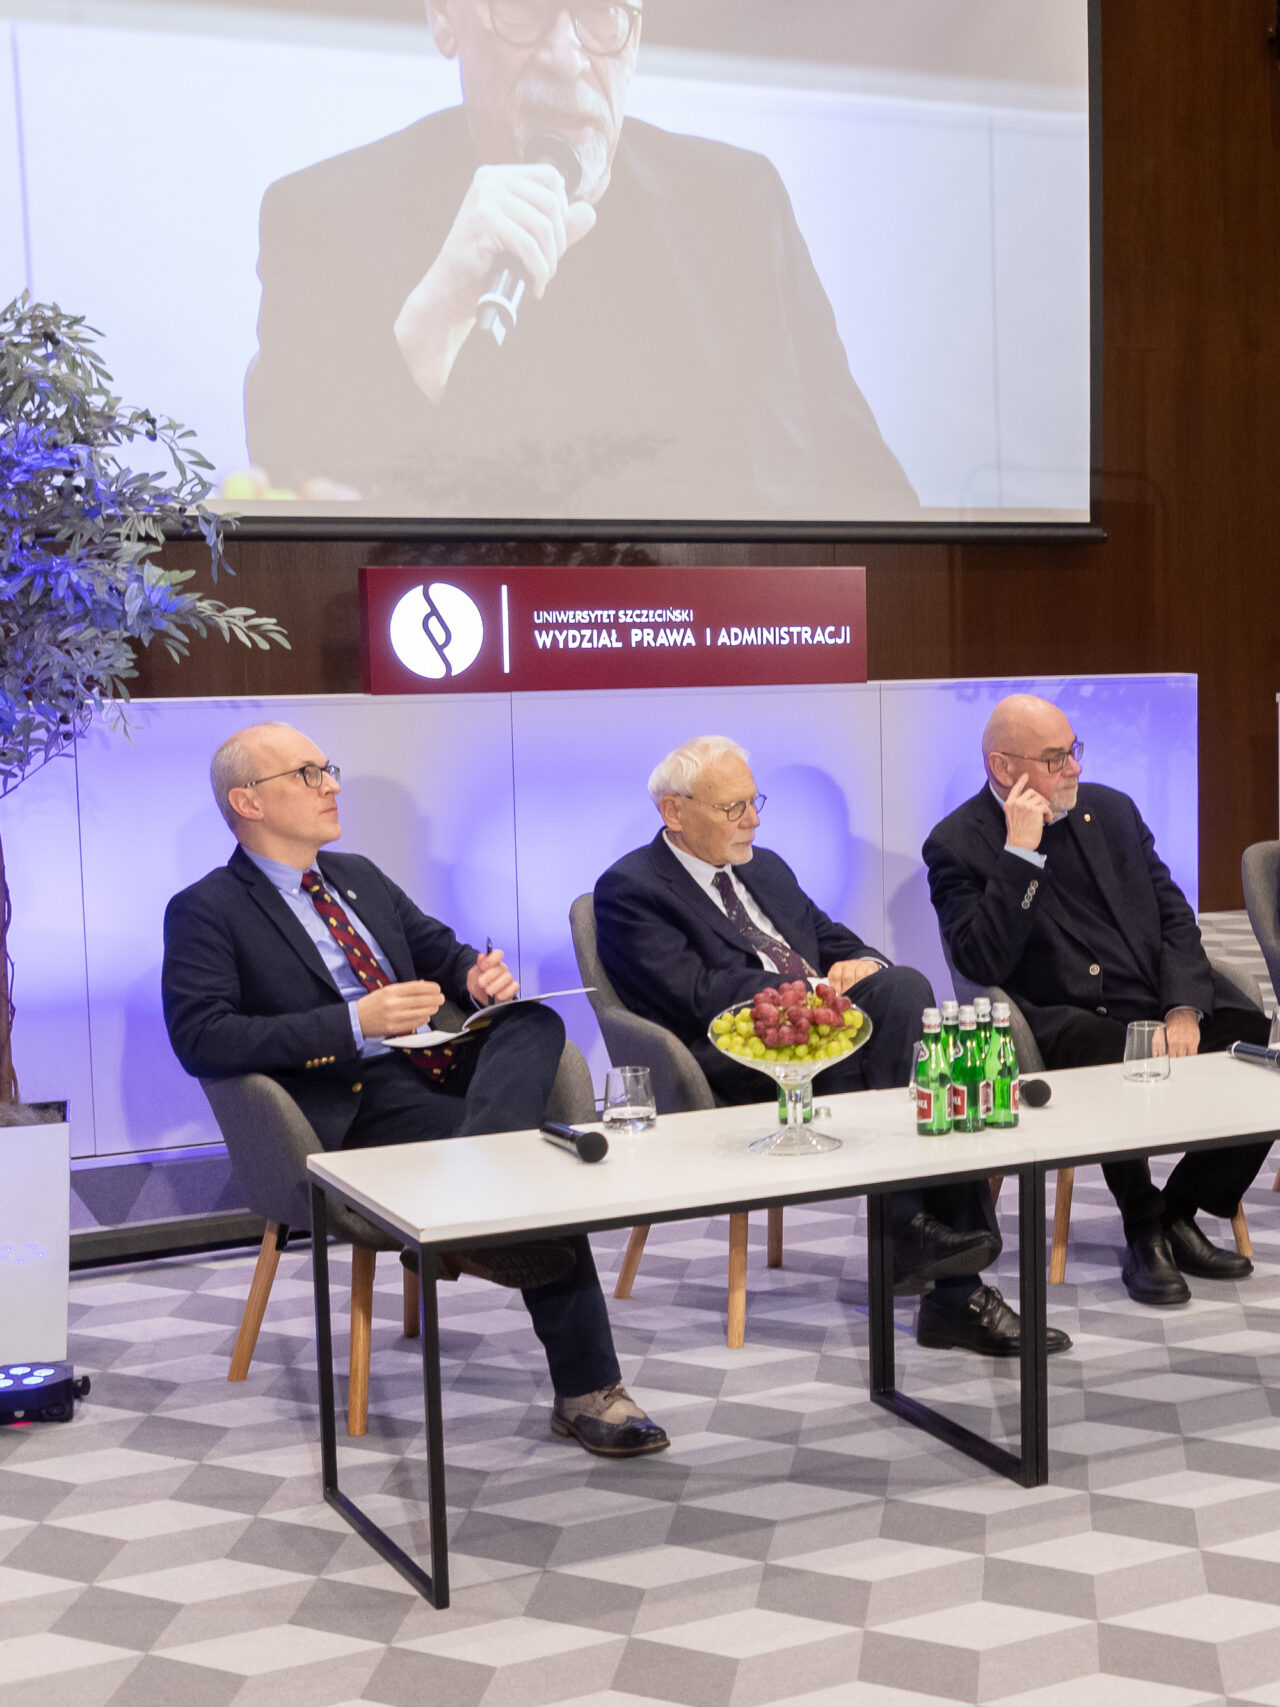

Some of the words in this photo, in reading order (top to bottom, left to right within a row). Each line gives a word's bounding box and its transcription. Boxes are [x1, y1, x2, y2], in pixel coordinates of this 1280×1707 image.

[533, 610, 616, 624] UNIWERSYTET
[618, 606, 694, 623] SZCZECIŃSKI
[534, 629, 623, 650] WYDZIAŁ
[631, 627, 696, 648] PRAWA
[705, 627, 712, 647] I
[717, 625, 851, 647] ADMINISTRACJI
